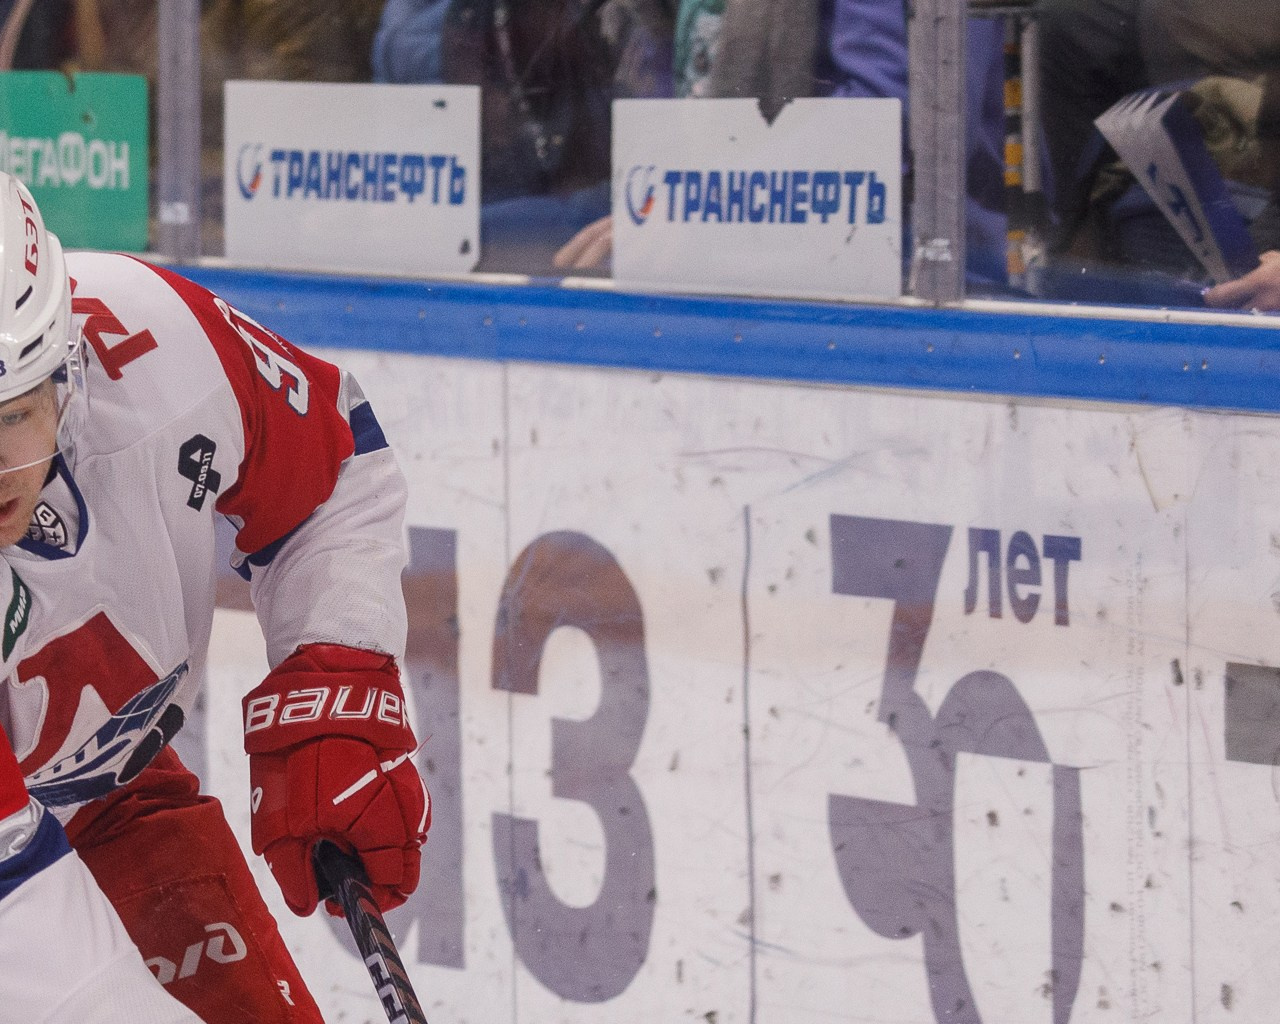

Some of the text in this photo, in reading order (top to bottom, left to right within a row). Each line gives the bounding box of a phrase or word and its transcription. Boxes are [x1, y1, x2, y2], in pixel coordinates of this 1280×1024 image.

[270, 147, 467, 205] ТРАНСНЕФТЬ
[663, 170, 887, 225] ТРАНСНЕФТЬ
[964, 527, 1083, 628] лет
